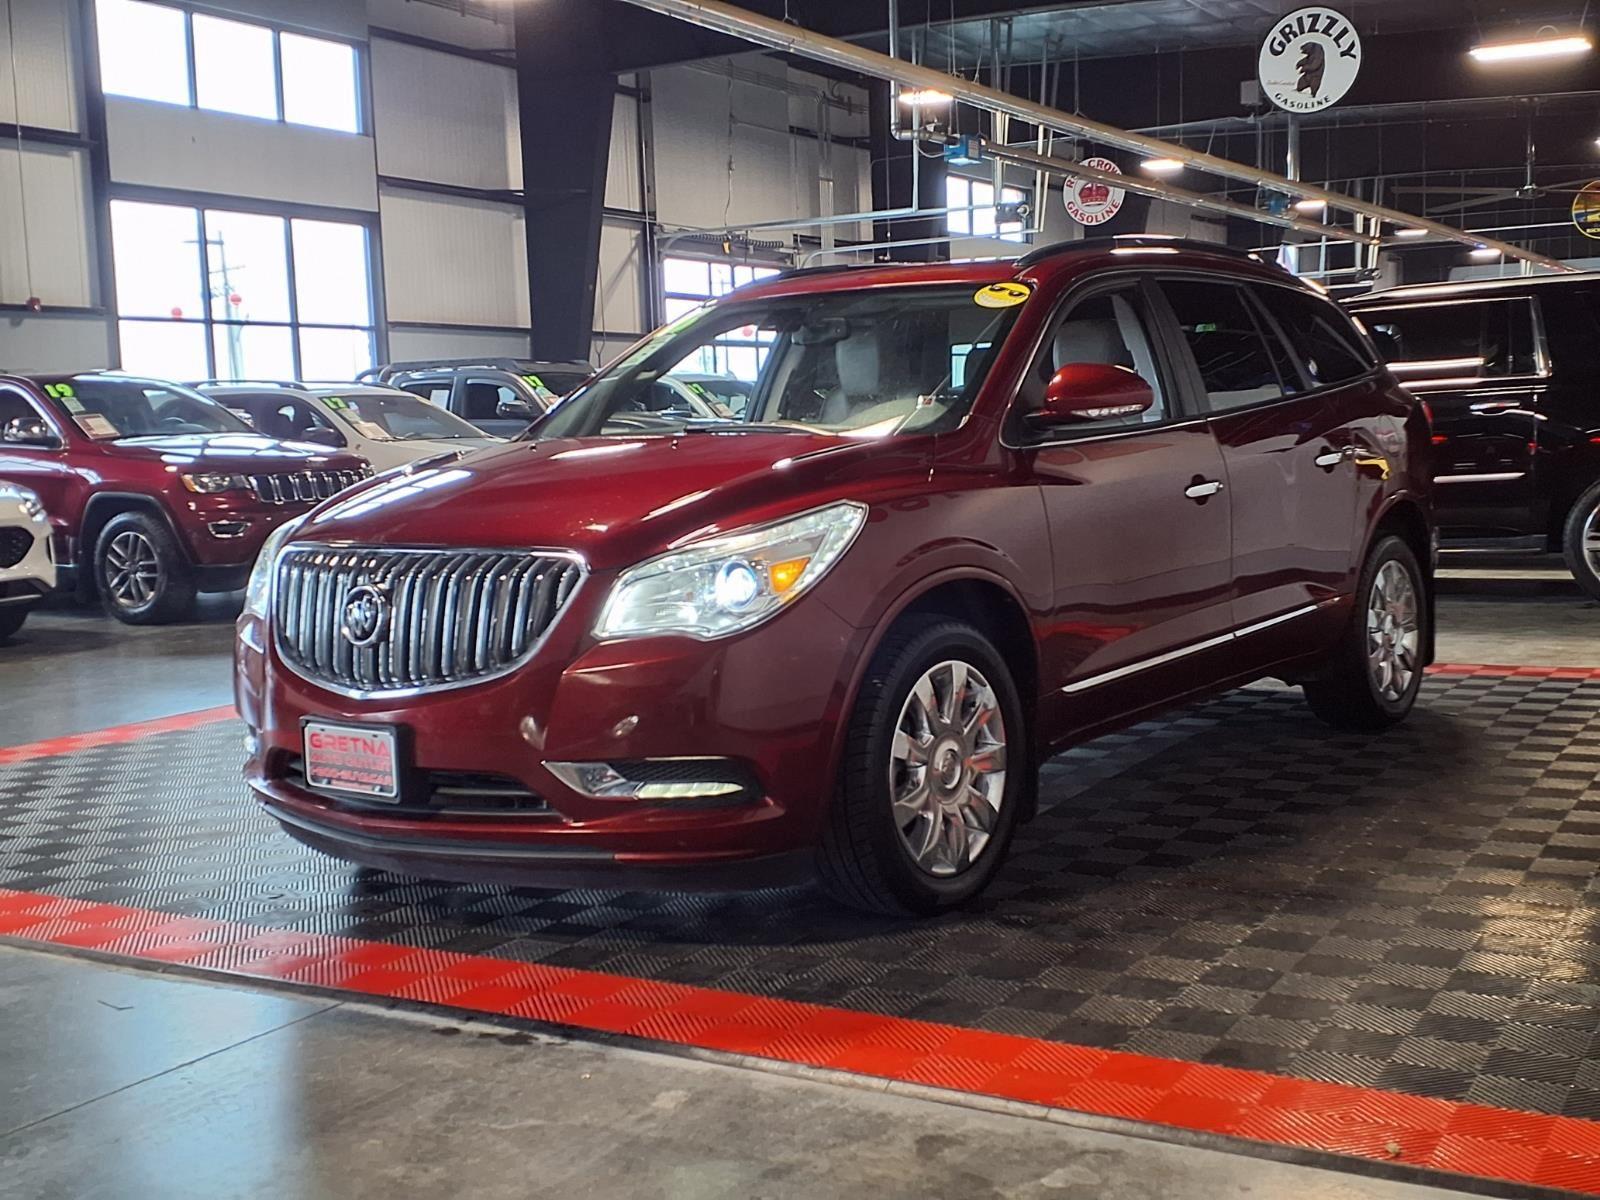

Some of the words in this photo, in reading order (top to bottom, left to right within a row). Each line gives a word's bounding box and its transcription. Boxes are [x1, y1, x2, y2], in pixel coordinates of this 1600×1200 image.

[1269, 13, 1357, 60] GRIZZLY
[1274, 92, 1331, 110] GASOLINE
[1067, 199, 1121, 224] GASOLINE
[43, 383, 74, 399] 19
[310, 732, 390, 757] GRETNA
